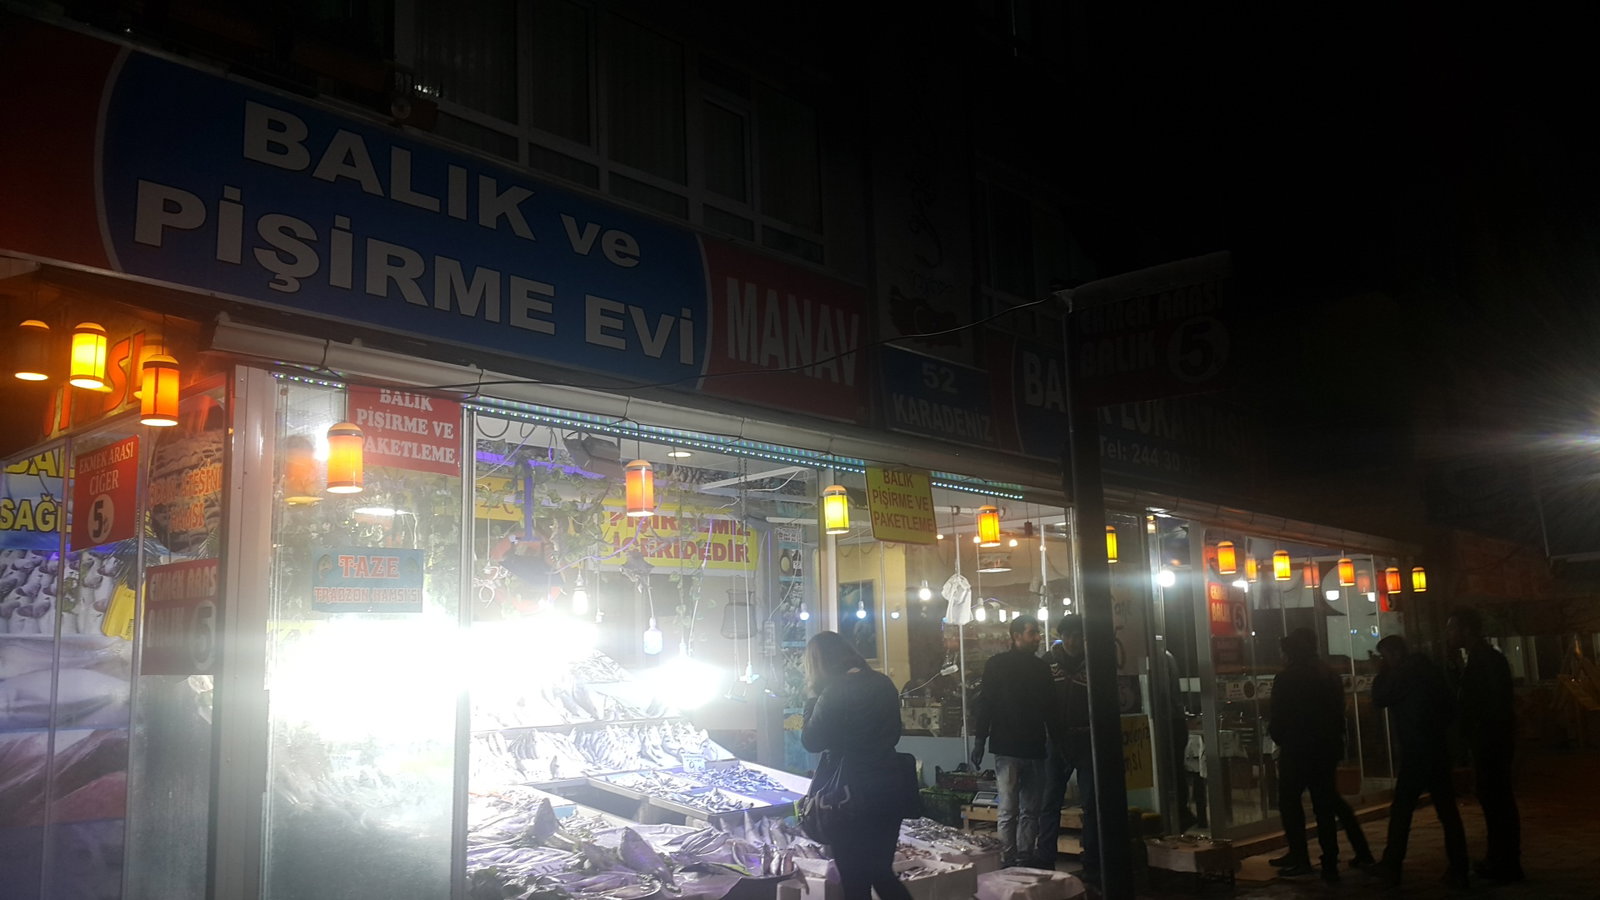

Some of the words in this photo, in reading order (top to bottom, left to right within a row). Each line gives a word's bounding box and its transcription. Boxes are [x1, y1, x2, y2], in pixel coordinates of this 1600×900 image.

[243, 98, 537, 242] BALIK
[559, 212, 641, 268] ve
[133, 177, 556, 336] PİŞİRME
[725, 275, 860, 387] MANAV
[921, 361, 959, 394] 52
[379, 388, 434, 412] BALIK
[892, 391, 994, 441] KARADENİZ
[356, 406, 429, 435] PİŞİRME
[432, 420, 455, 440] VE
[79, 450, 108, 474] EKMEK
[108, 441, 134, 465] ARASI
[363, 436, 456, 465] AKETLEME
[1099, 434, 1128, 462] Tel:
[1131, 442, 1159, 469] 244
[89, 467, 119, 496] CİĞER
[882, 469, 914, 488] BALIK
[872, 486, 914, 510] PİŞİRME
[915, 495, 930, 512] VE
[92, 499, 104, 538] 5
[873, 510, 936, 533] PAKETLEME
[186, 565, 217, 599] ARAS
[338, 554, 400, 579] TAZE
